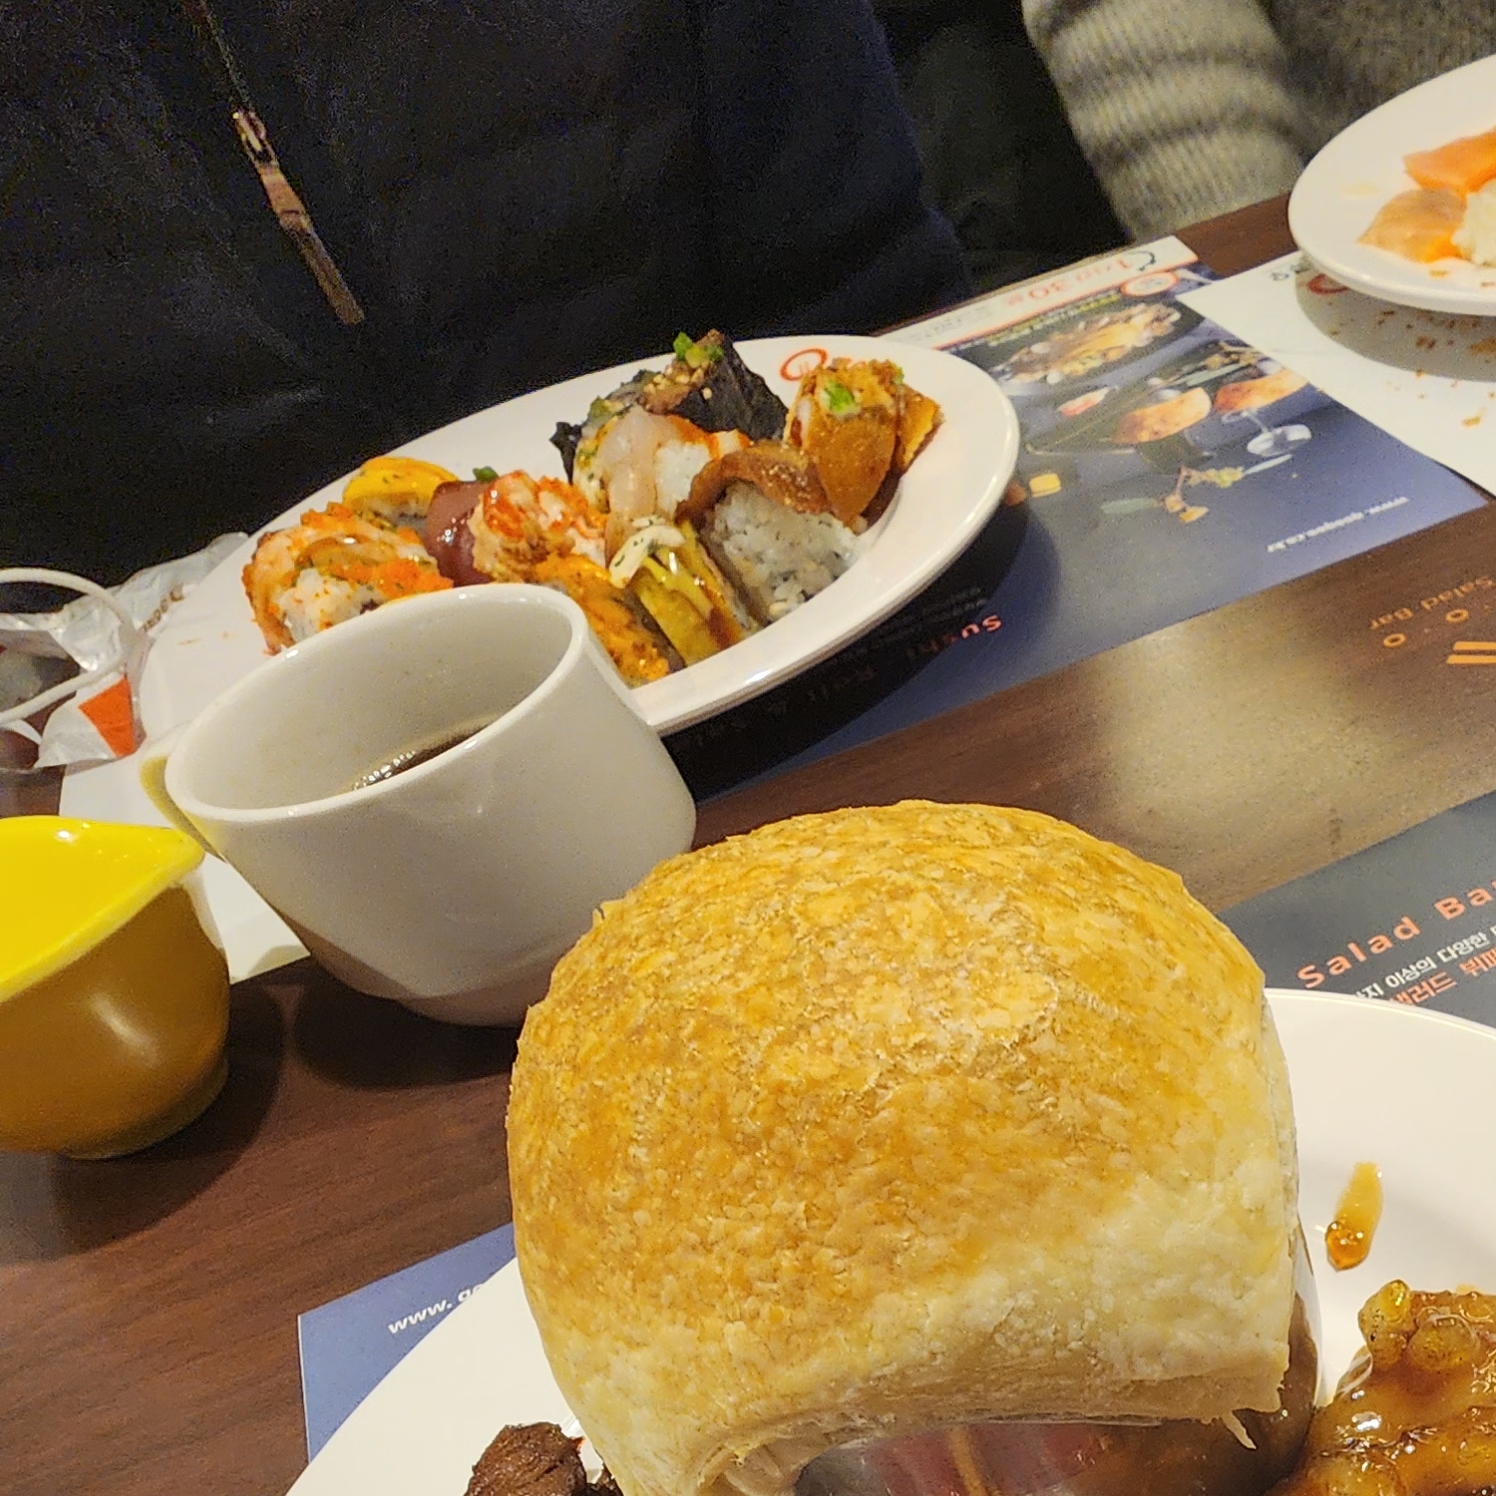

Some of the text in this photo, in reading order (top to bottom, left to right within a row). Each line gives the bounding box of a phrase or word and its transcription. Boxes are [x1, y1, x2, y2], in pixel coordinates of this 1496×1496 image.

[1370, 607, 1414, 630] Bar
[1296, 916, 1421, 989] Salad
[1384, 956, 1437, 988] 이상의
[1436, 932, 1490, 963] 다양한
